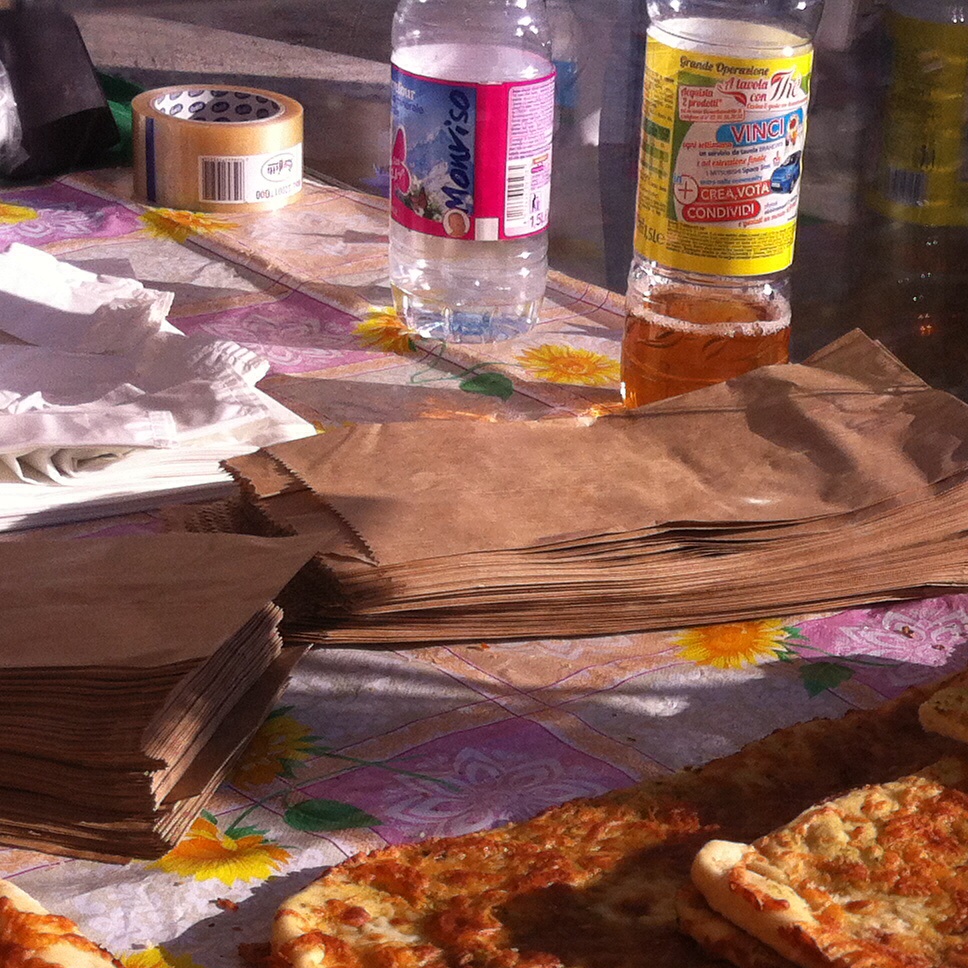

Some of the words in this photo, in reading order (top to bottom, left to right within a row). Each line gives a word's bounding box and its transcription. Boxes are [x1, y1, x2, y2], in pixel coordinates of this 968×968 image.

[680, 56, 714, 71] Grande
[716, 63, 770, 76] Operazione
[736, 78, 768, 90] tavola
[682, 98, 687, 107] 2
[750, 92, 767, 102] con
[730, 118, 785, 143] VINCI
[441, 89, 471, 214] Monviso
[738, 182, 770, 197] VOTA
[686, 203, 755, 219] CONDIVIDI
